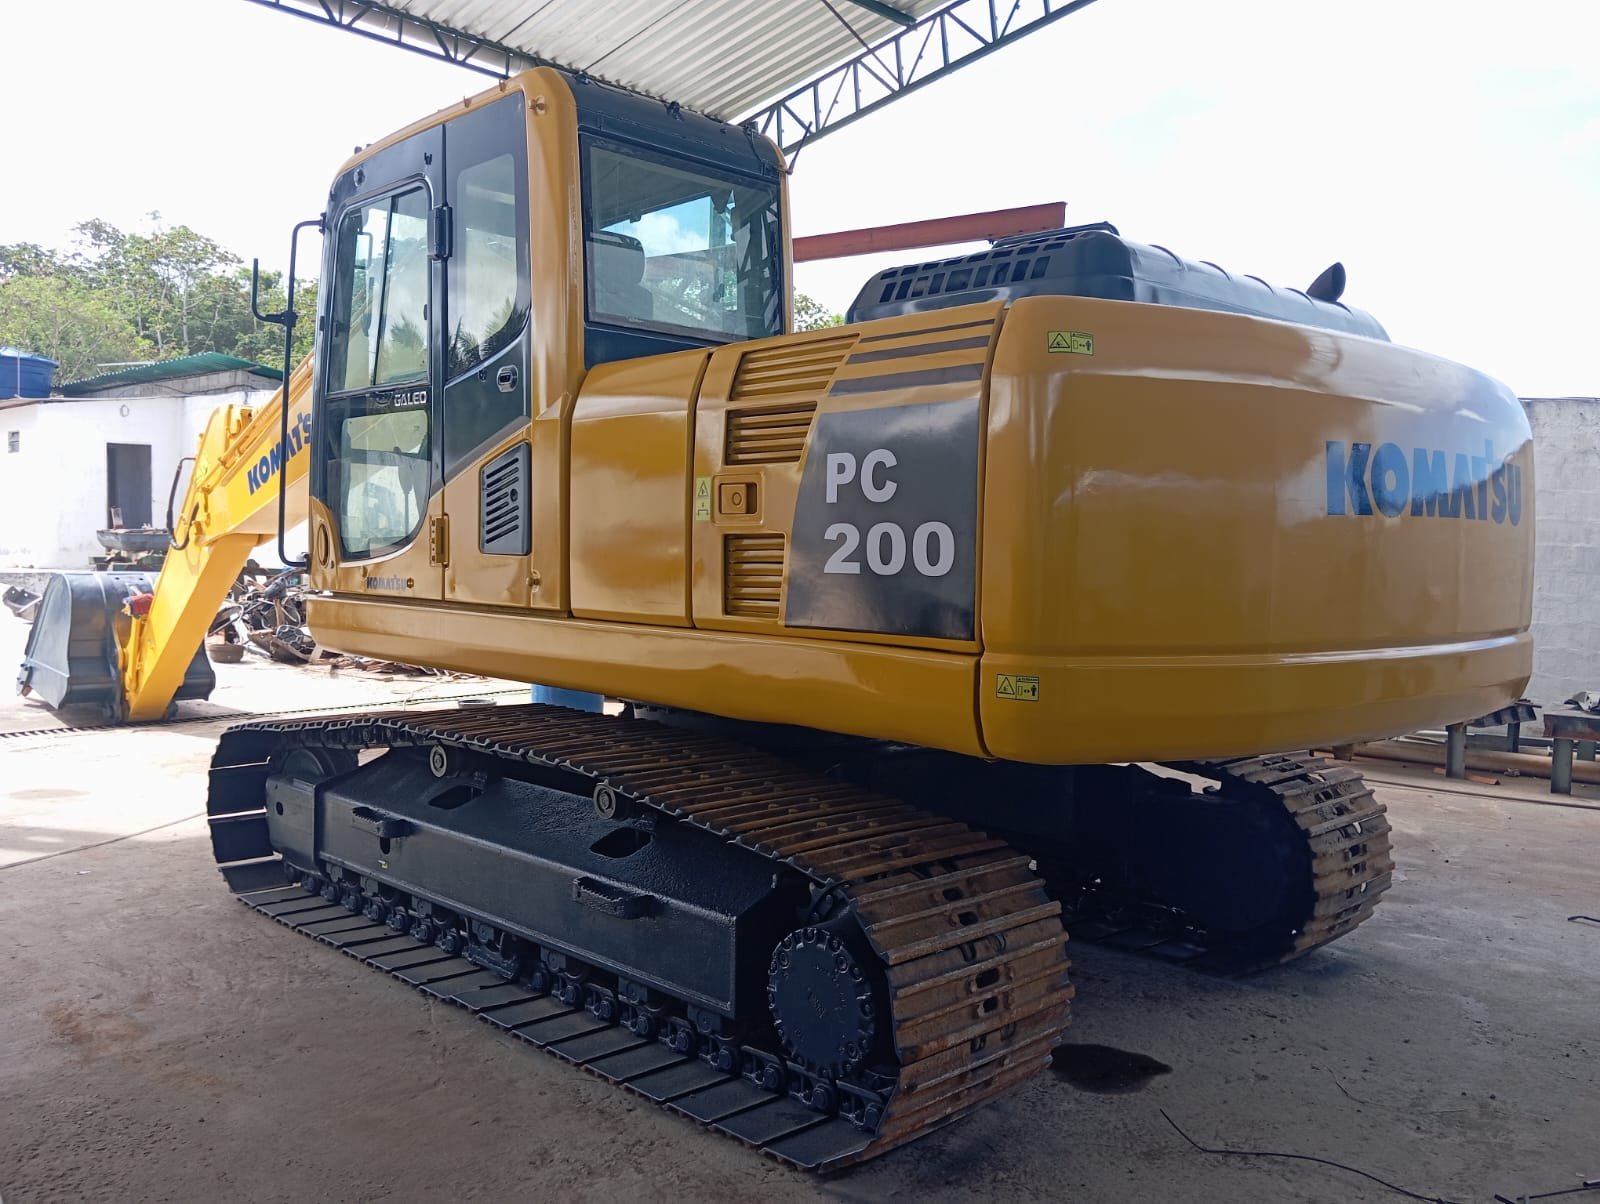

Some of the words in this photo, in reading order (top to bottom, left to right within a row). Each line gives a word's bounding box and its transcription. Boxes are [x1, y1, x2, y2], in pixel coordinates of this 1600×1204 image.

[394, 391, 427, 407] GALEO
[826, 448, 898, 504] PC
[1326, 439, 1521, 527] KOMATSU
[823, 521, 955, 577] 200
